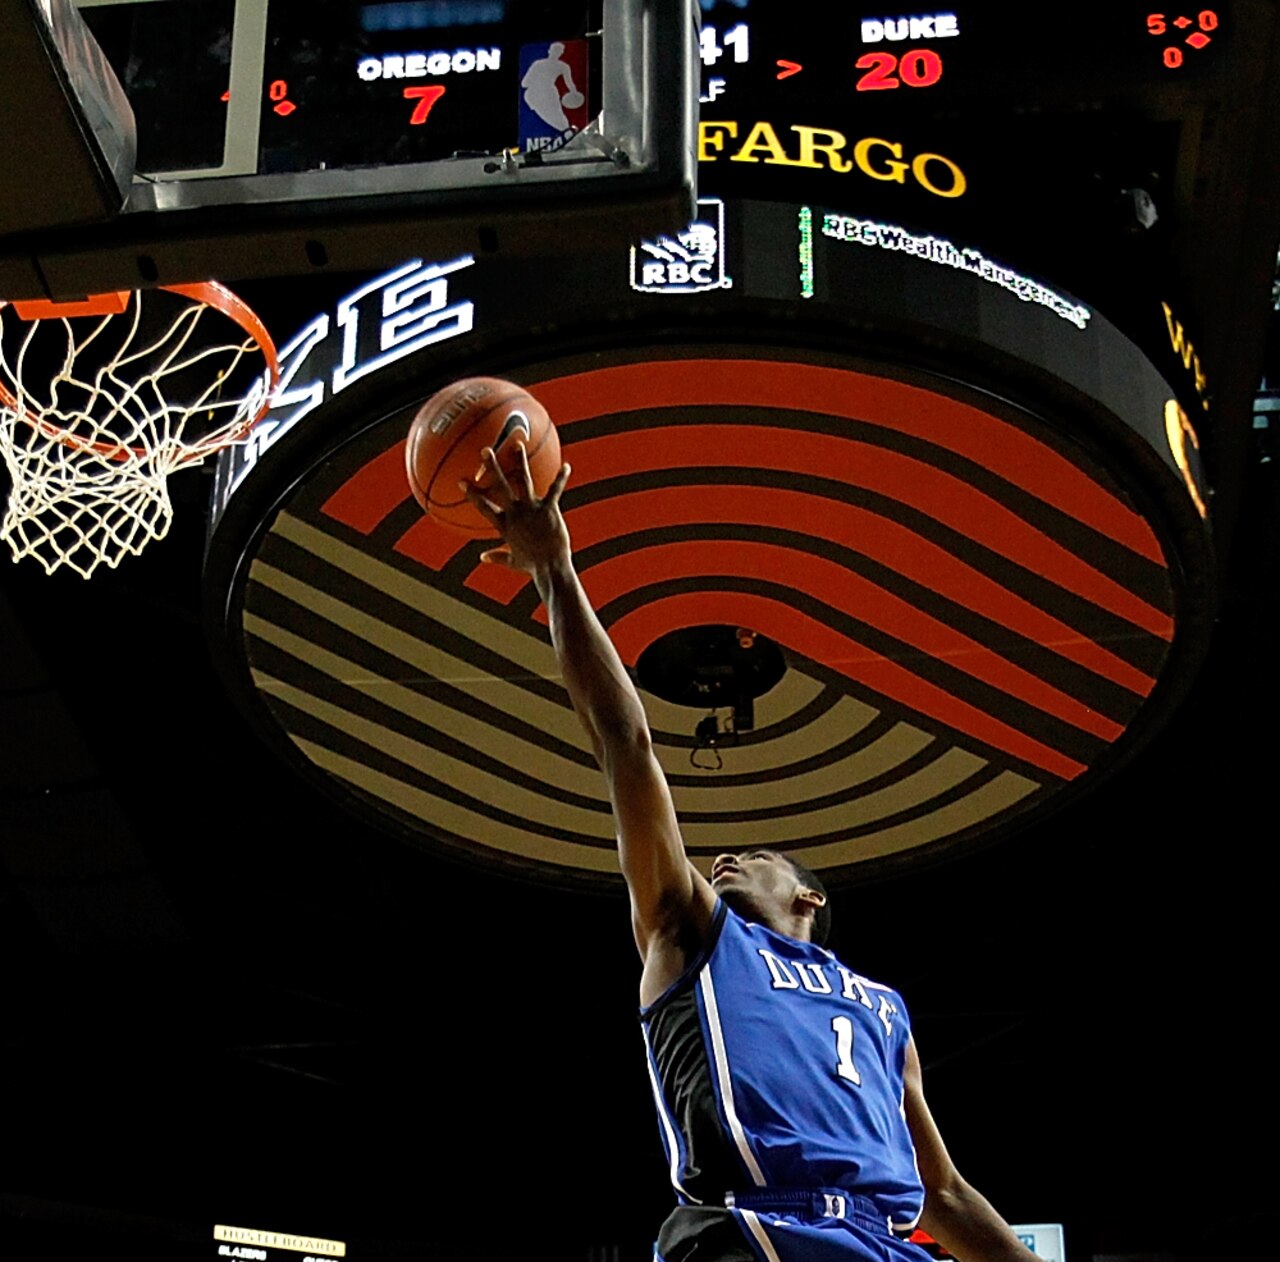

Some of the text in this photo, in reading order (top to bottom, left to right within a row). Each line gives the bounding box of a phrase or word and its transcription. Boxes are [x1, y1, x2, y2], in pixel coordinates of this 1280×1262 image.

[861, 15, 960, 42] DUKE
[357, 49, 501, 82] OREGON
[856, 49, 942, 91] 20
[403, 85, 445, 125] 7
[698, 121, 966, 198] FARGO
[642, 262, 713, 285] RBC
[822, 214, 1091, 328] RBC Wealth Management
[758, 947, 899, 1037] DUKE
[831, 1014, 862, 1086] 1
